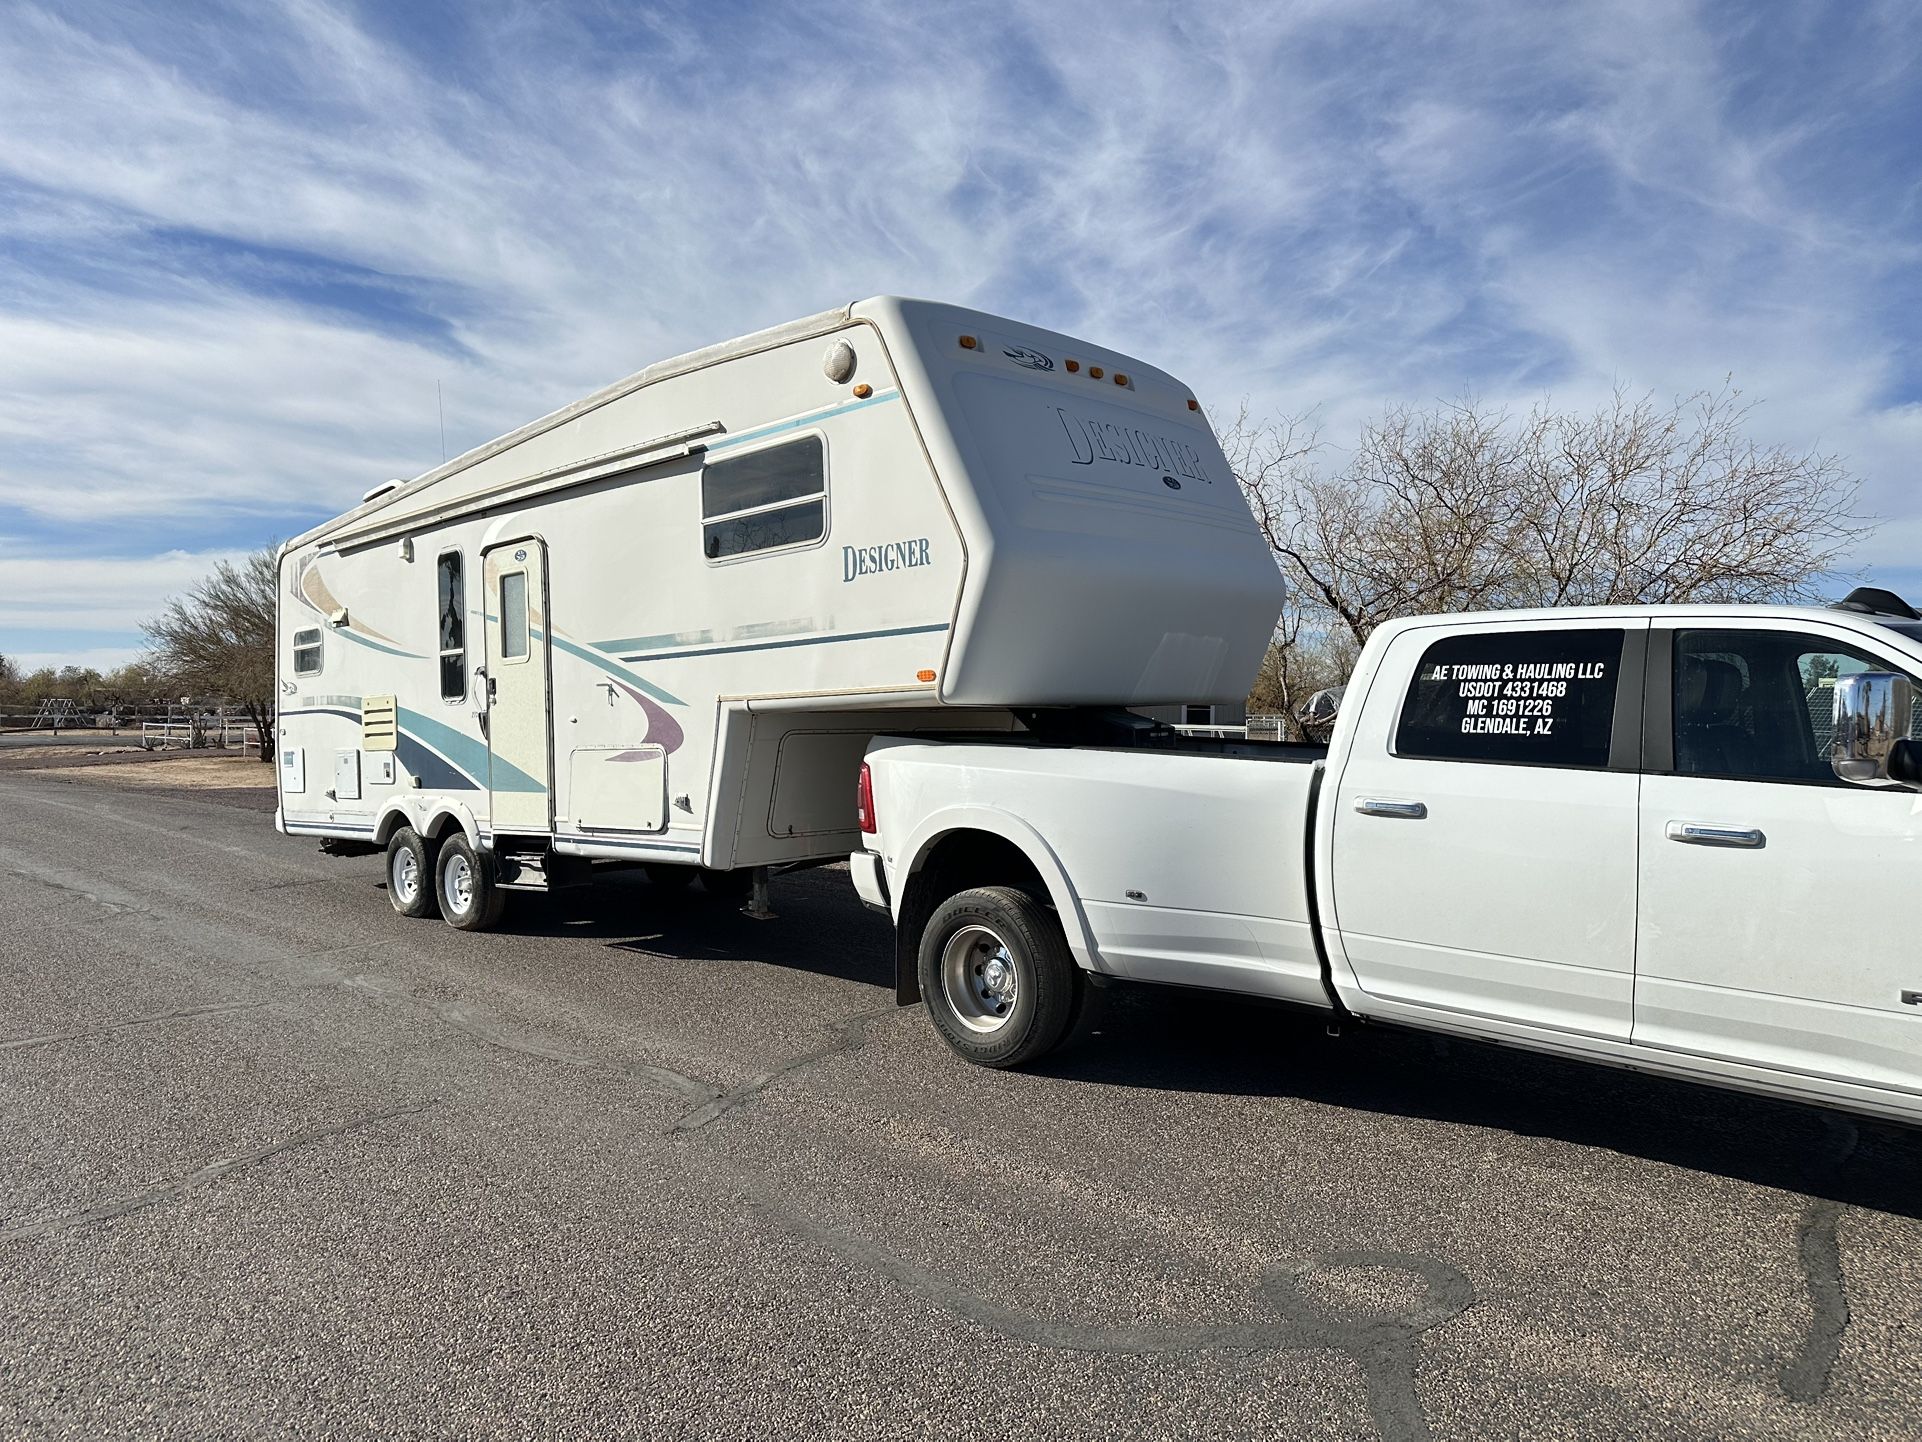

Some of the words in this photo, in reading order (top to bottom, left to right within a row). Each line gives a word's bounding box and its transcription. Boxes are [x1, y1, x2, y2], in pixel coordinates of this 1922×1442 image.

[1056, 407, 1212, 484] DESIGNER
[842, 538, 931, 582] DESIGNER
[1431, 665, 1449, 680] AE
[1451, 664, 1501, 680] TOWING
[1502, 664, 1515, 679] &
[1517, 663, 1575, 679] HAULING
[1577, 663, 1604, 679] LLC
[1458, 682, 1502, 697] USDOT
[1503, 681, 1566, 697] 4331468
[1466, 700, 1487, 715] MC
[1491, 700, 1552, 716] 1691226
[1461, 718, 1531, 736] GLENDALE,
[1534, 718, 1553, 735] AZ
